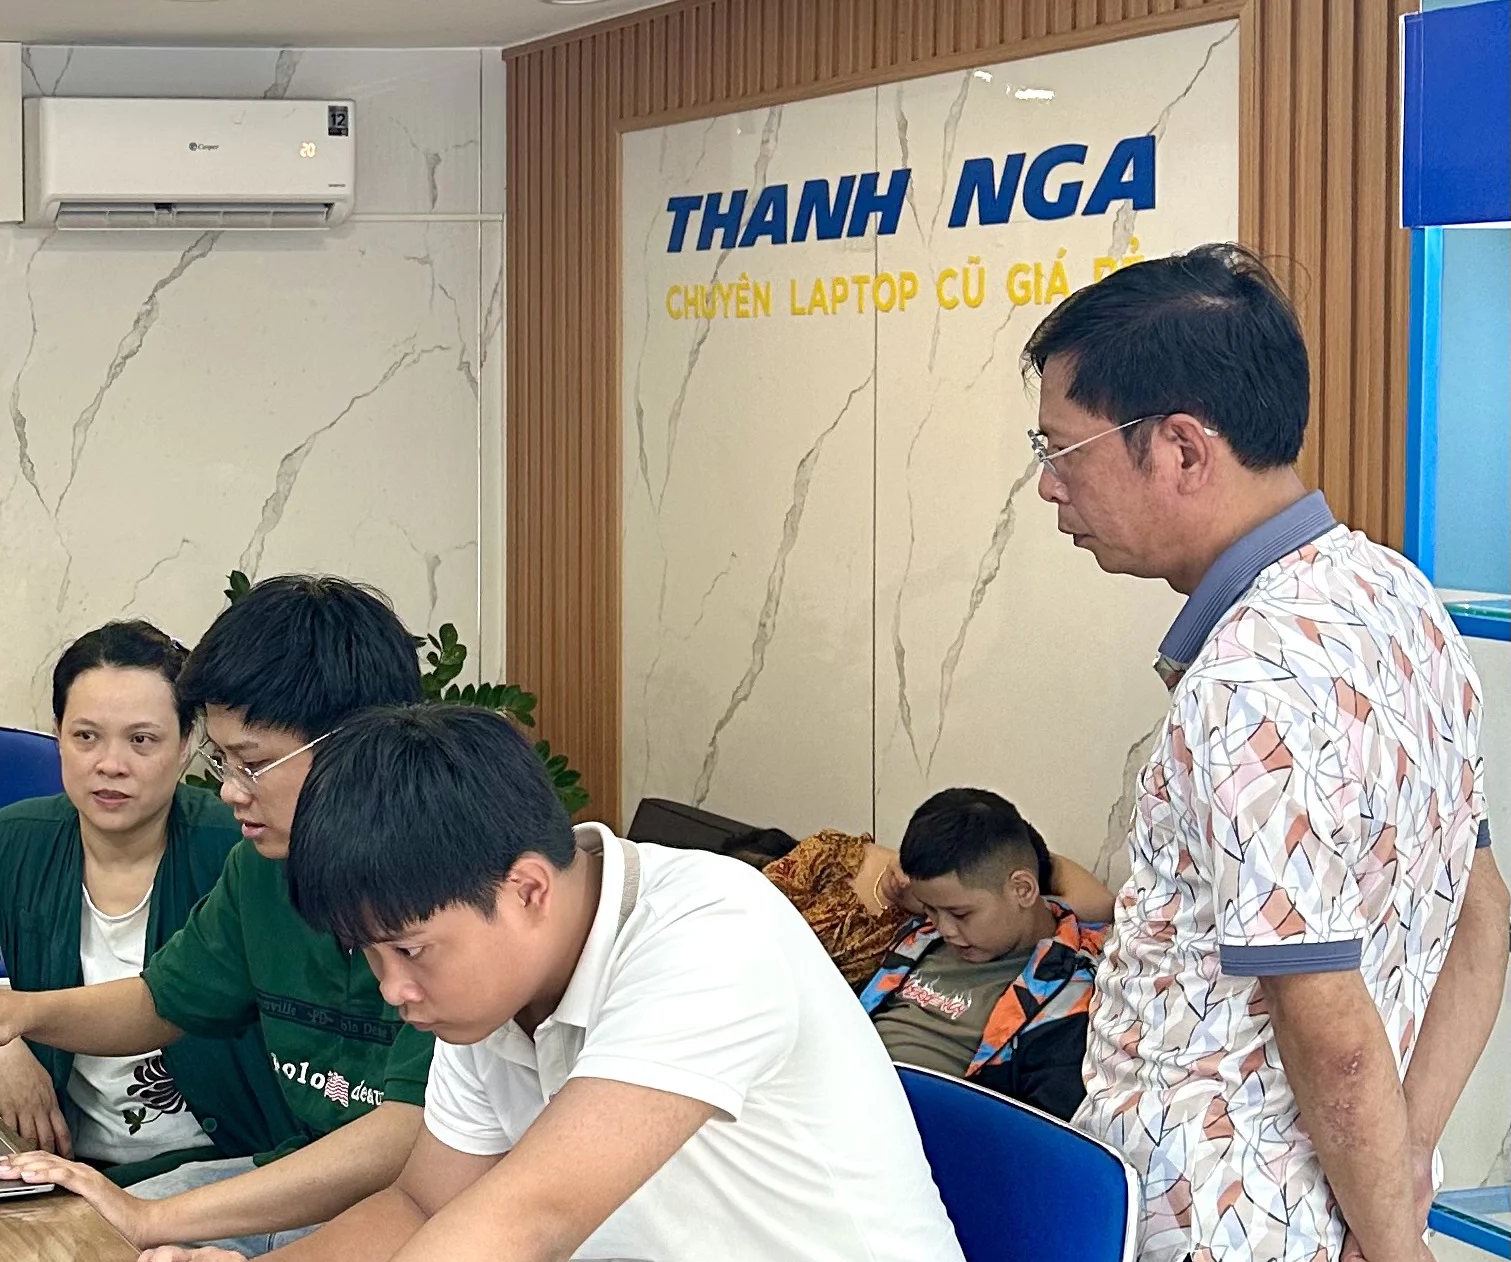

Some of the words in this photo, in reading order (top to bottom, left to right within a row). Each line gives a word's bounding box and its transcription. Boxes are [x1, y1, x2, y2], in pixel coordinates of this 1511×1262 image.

[330, 113, 346, 127] 12
[300, 142, 317, 158] 20
[666, 168, 912, 253] THANH
[947, 135, 1156, 228] NGA
[666, 272, 772, 320] CHUYÊN
[790, 271, 920, 316] LAPTOP
[937, 255, 986, 310] CŨ
[1006, 247, 1071, 306] GIÁ
